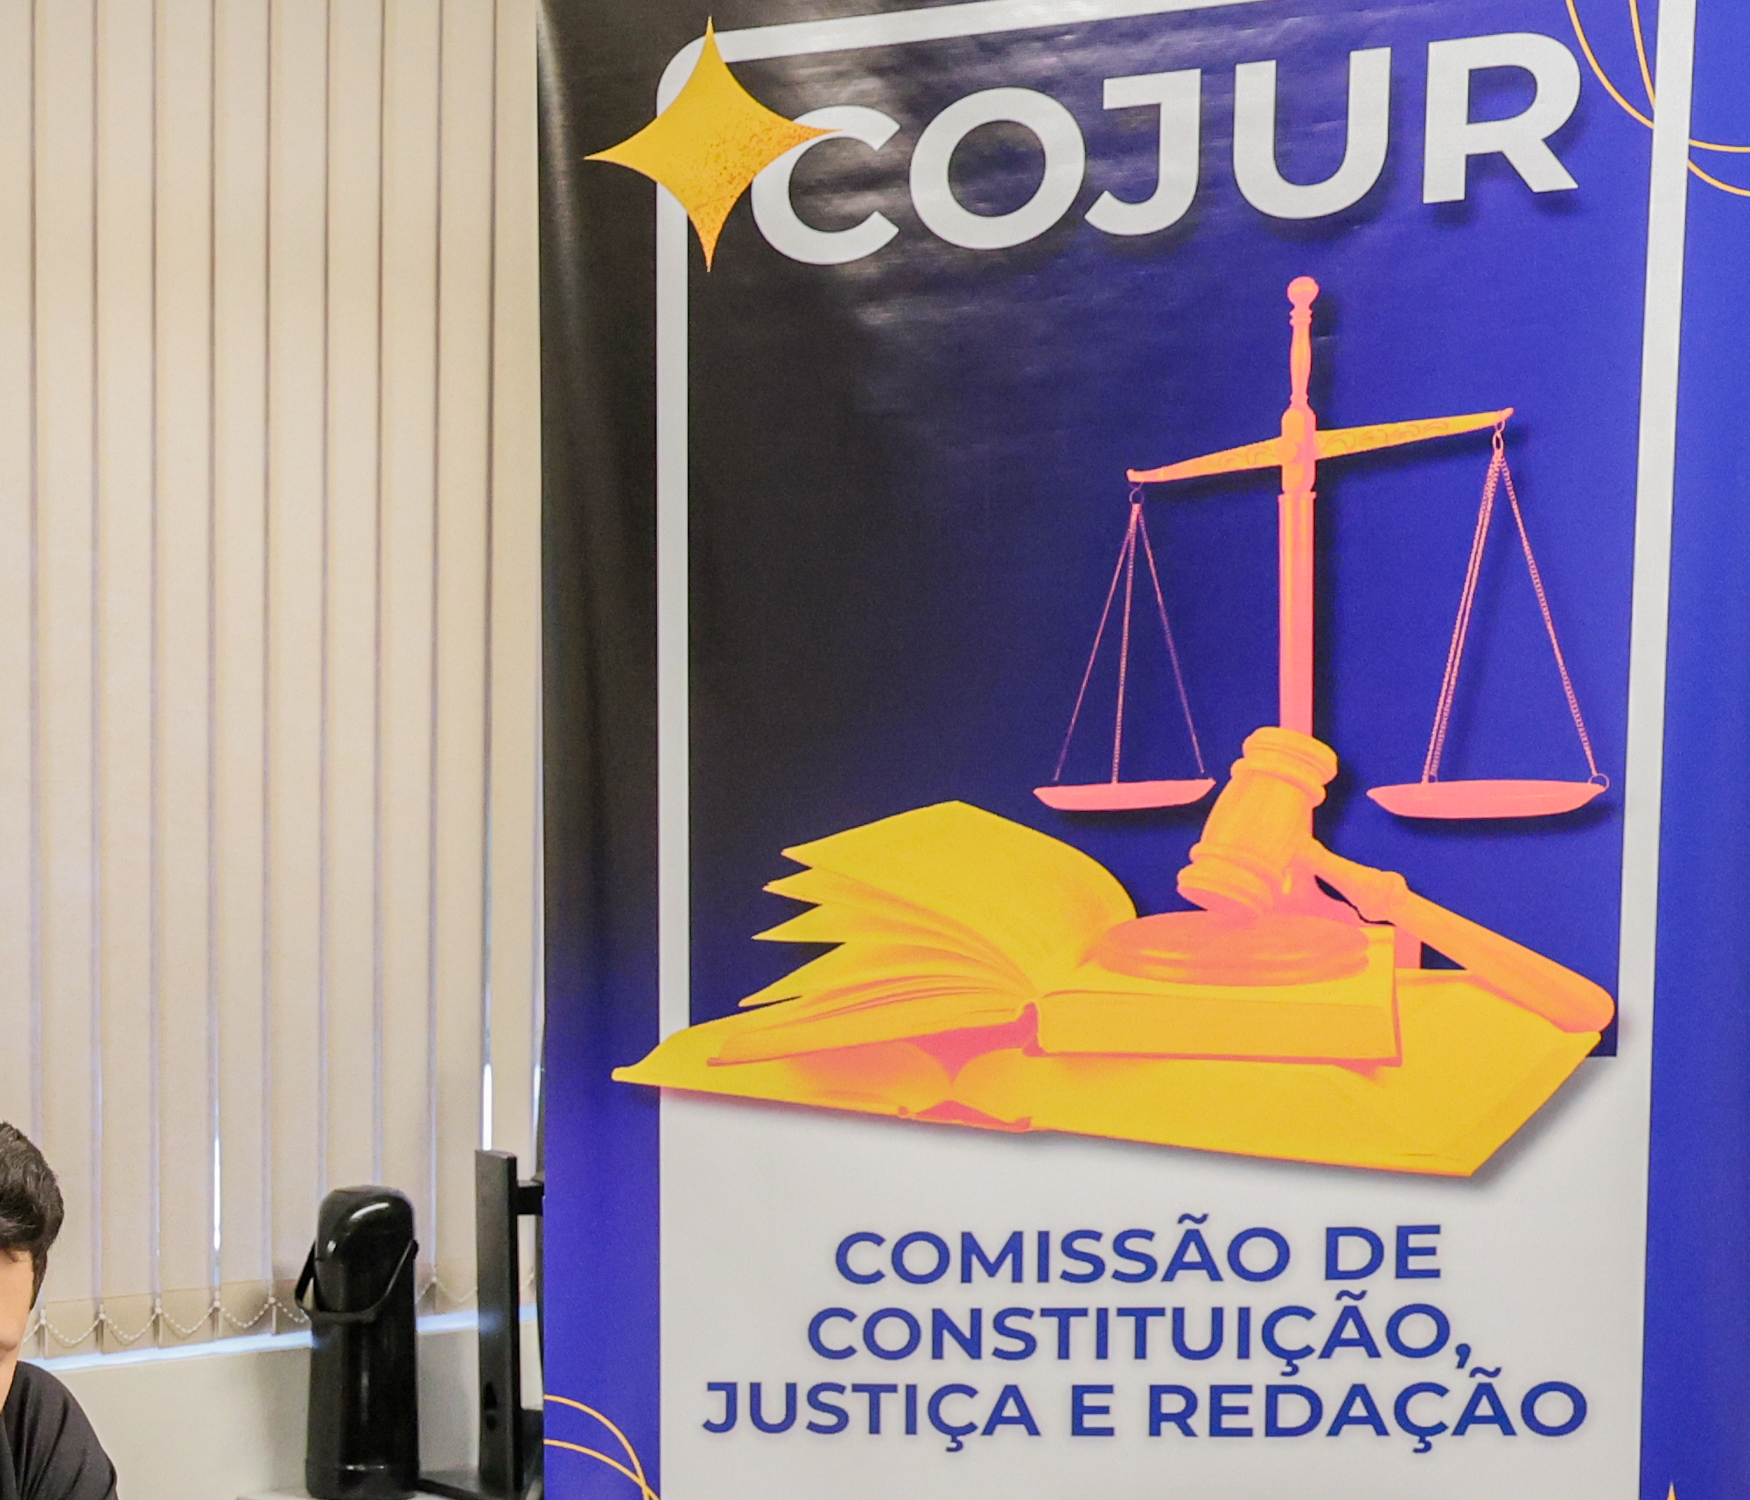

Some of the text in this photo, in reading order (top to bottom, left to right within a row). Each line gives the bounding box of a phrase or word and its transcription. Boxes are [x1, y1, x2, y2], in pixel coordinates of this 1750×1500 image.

[750, 32, 1581, 265] COJUR
[836, 1214, 1442, 1285] COMISSÃO DE
[808, 1290, 1472, 1377] CONSTITUIÇÃO,
[703, 1367, 1588, 1454] JUSTIÇA E REDAÇÃO
